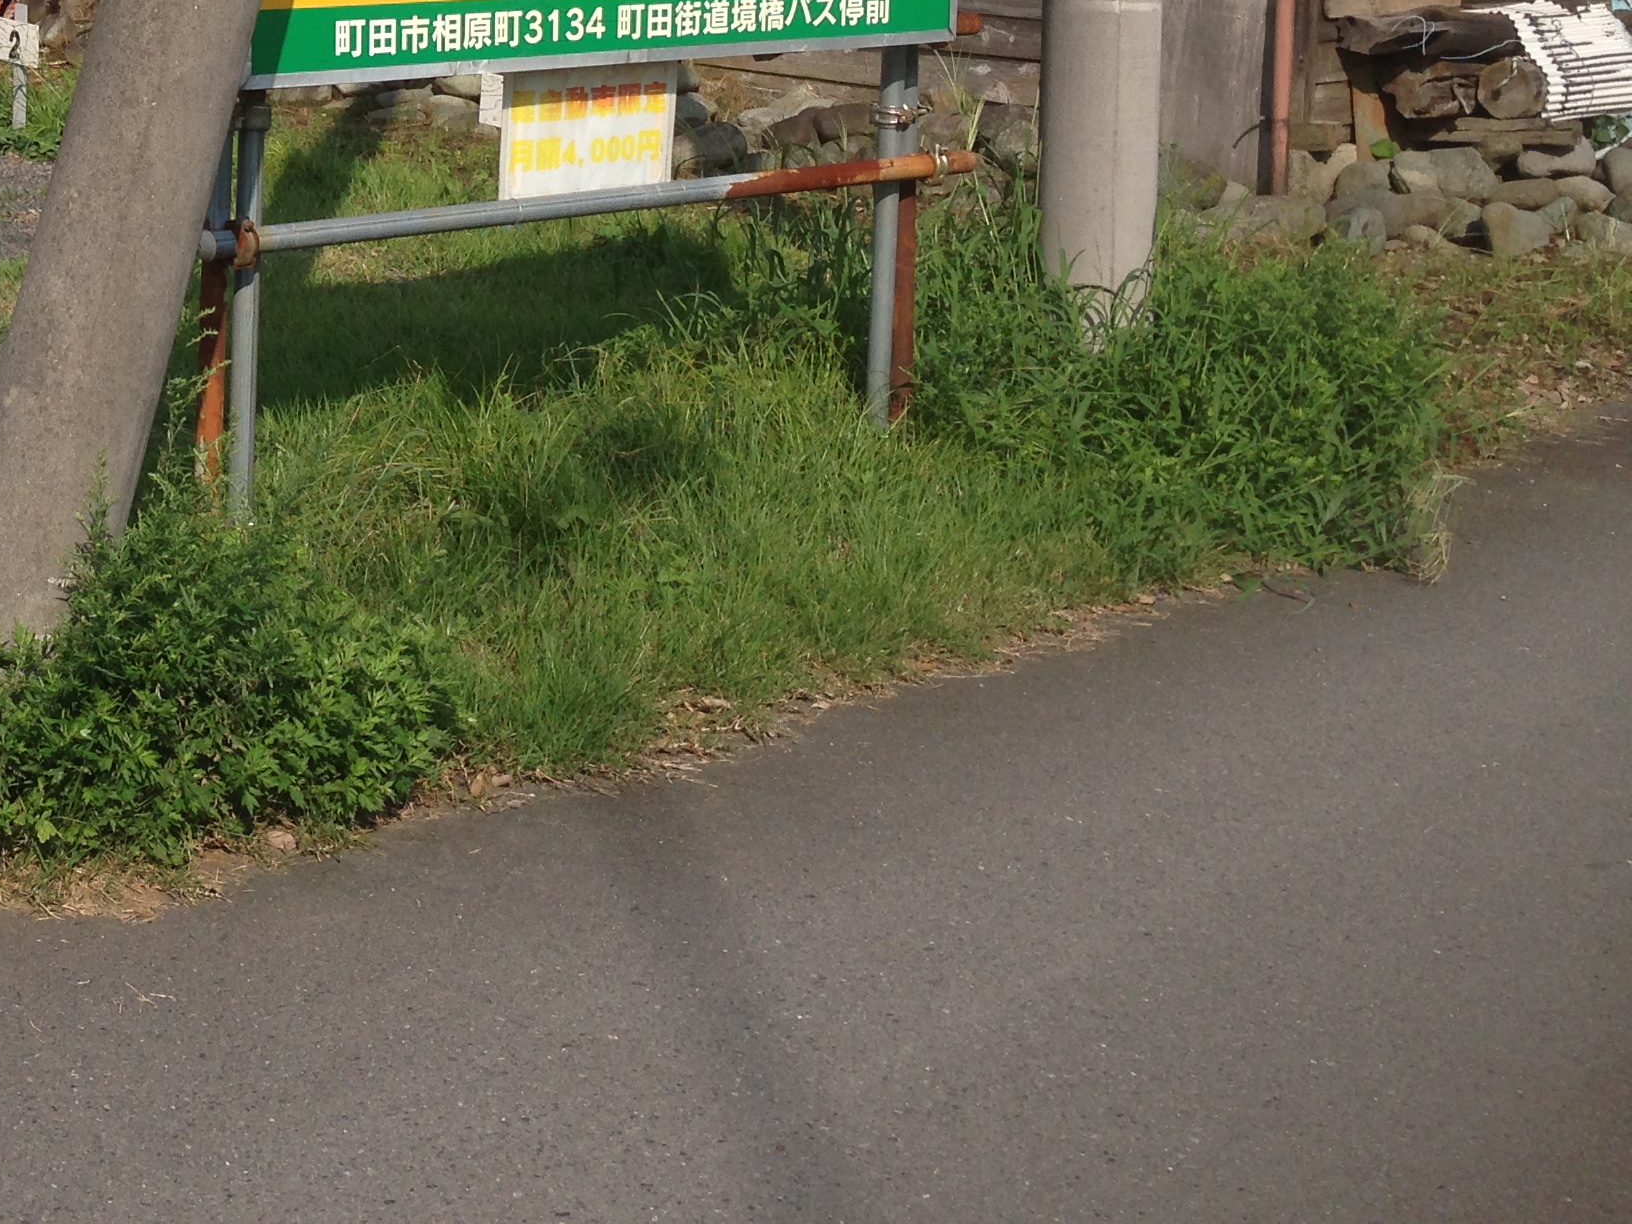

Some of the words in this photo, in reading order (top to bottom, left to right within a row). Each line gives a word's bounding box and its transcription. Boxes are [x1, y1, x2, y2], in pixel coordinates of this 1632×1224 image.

[8, 30, 22, 60] 2
[334, 6, 606, 58] 町田市相原町3134
